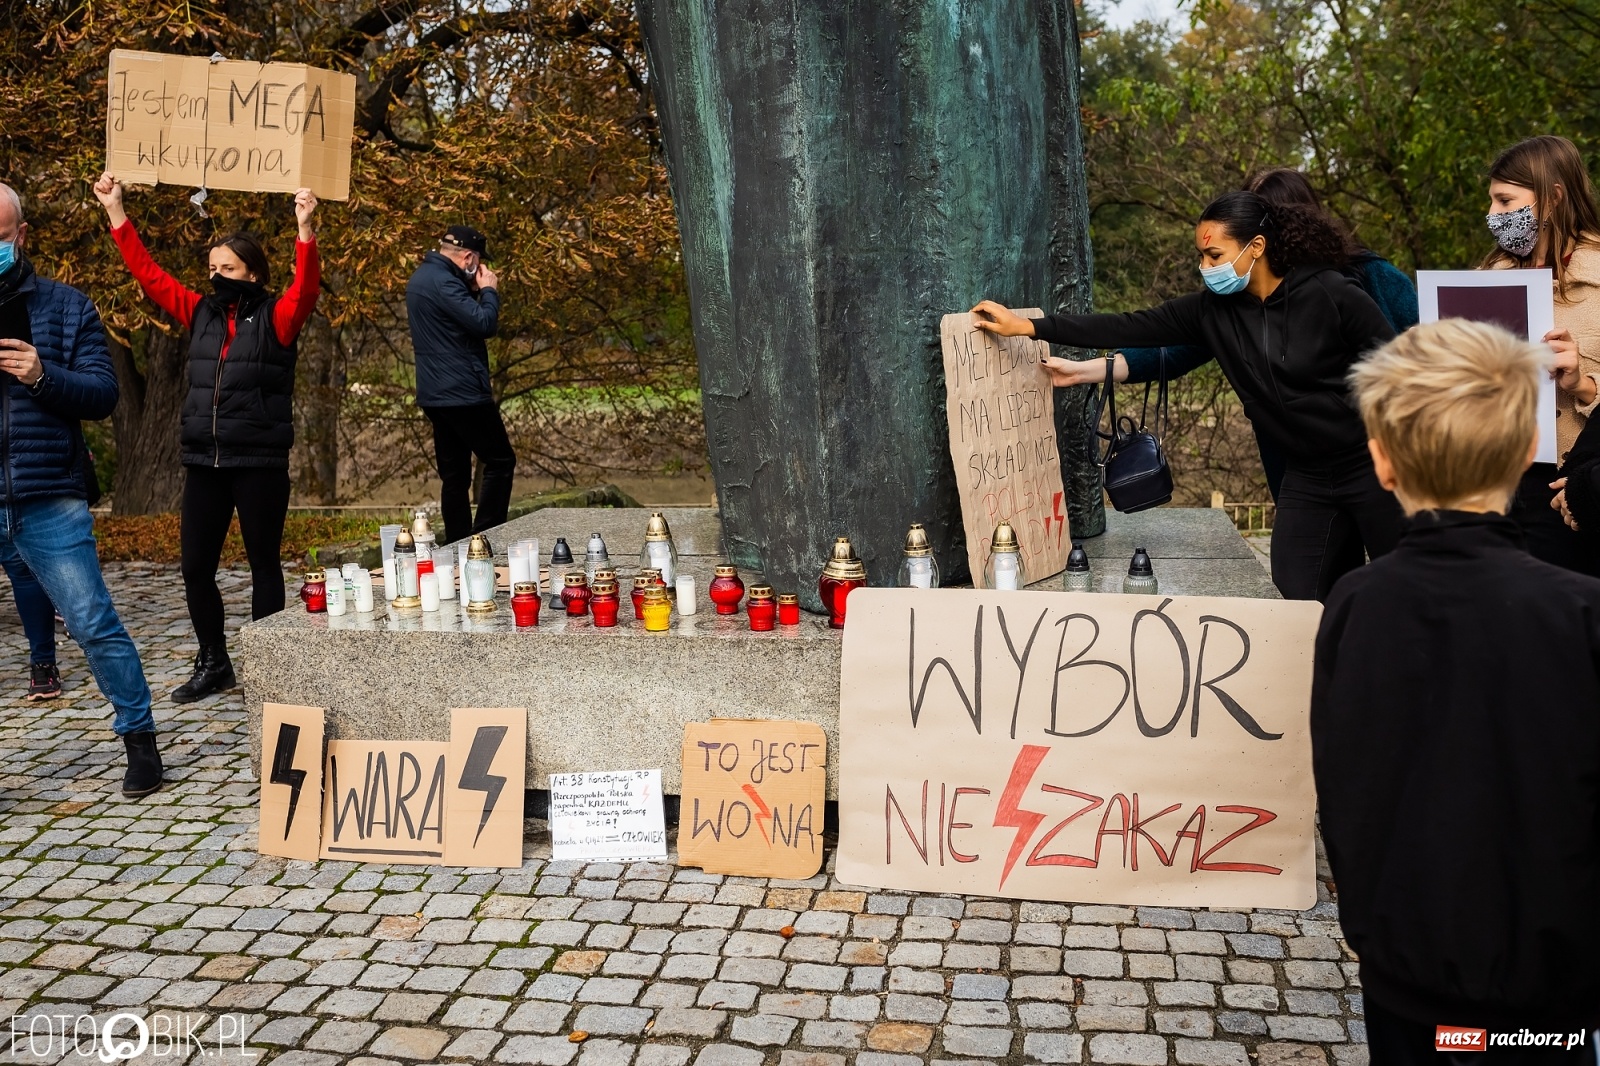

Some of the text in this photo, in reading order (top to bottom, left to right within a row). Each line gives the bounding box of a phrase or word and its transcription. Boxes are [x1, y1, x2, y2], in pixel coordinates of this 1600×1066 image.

[111, 69, 326, 141] Jestem MEGA
[137, 130, 291, 177] wkurzona
[960, 387, 1047, 442] MA LEPSZY
[969, 440, 1026, 490] SKŁAD
[909, 598, 1285, 740] WYBÓR
[570, 773, 584, 787] 38
[697, 738, 820, 784] TO JEST
[330, 750, 446, 845] WARA
[885, 779, 1284, 875] NIE ZAKAZ
